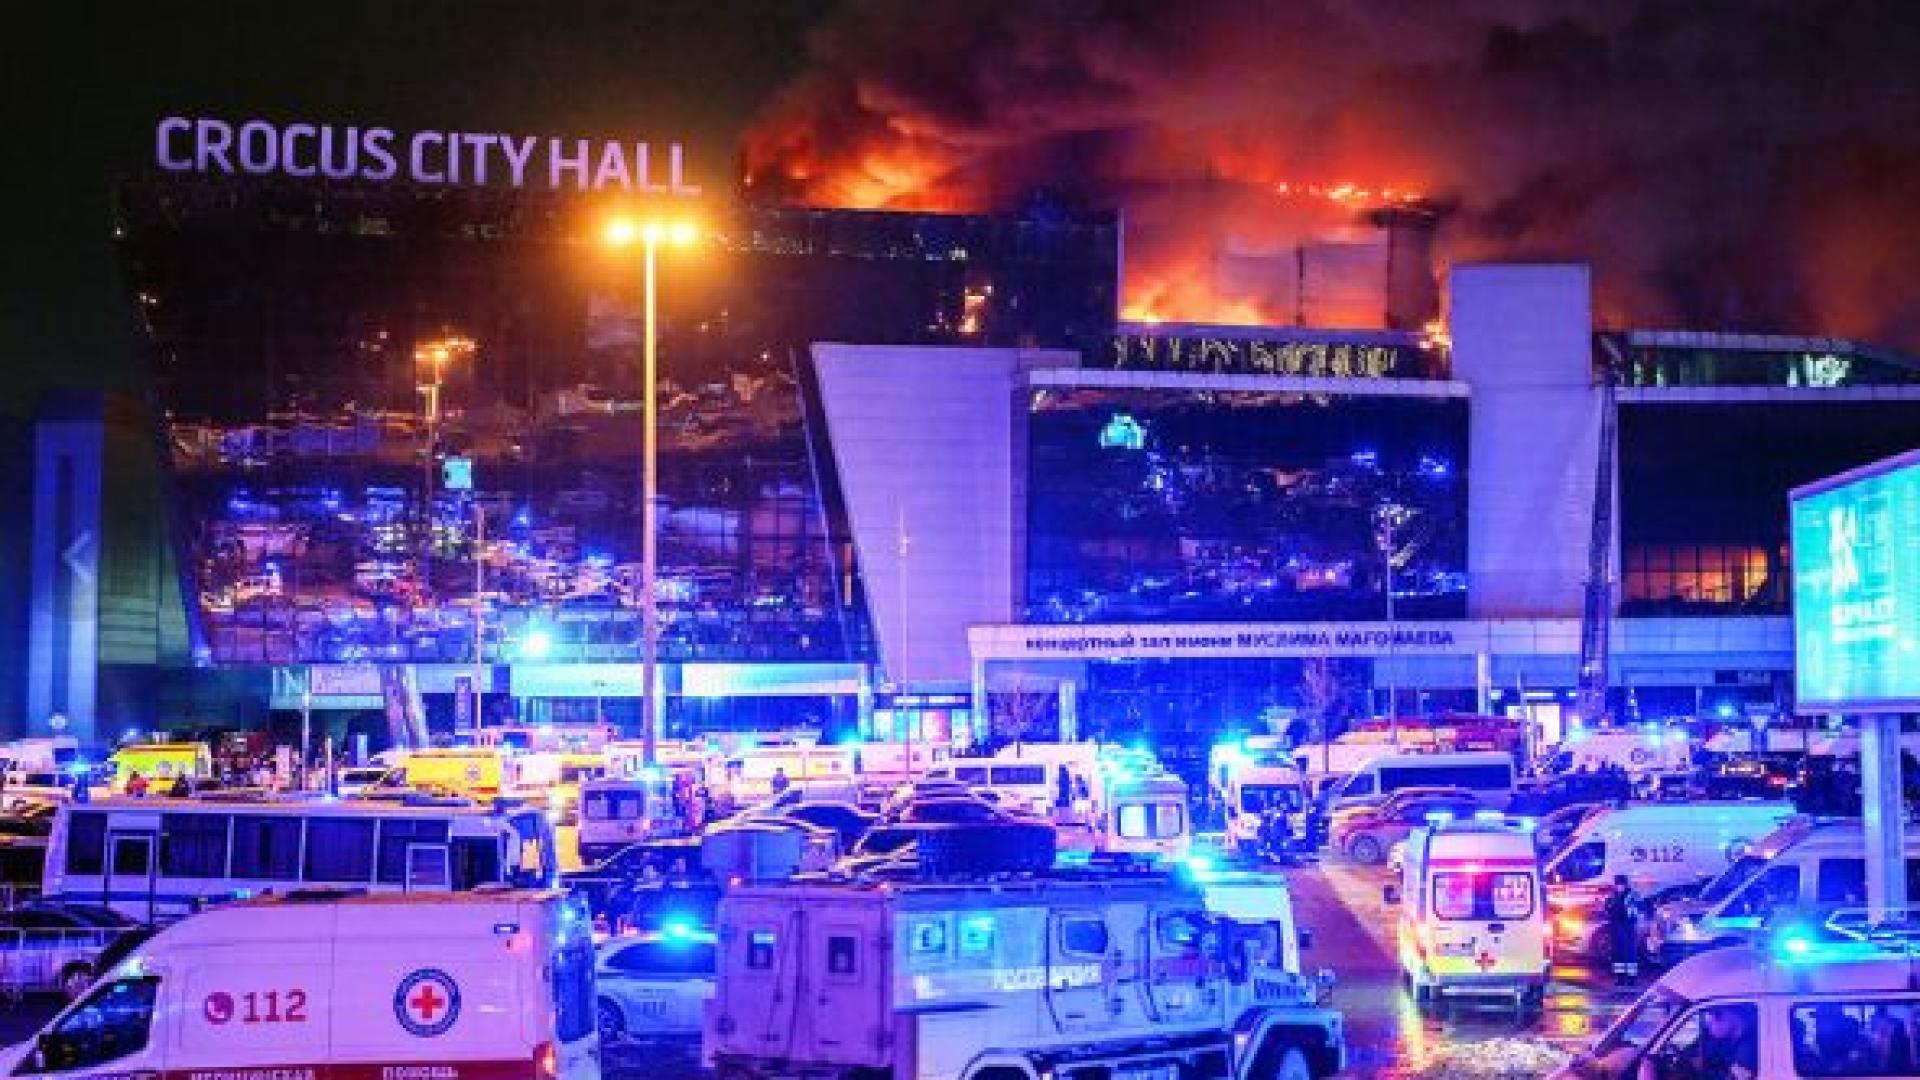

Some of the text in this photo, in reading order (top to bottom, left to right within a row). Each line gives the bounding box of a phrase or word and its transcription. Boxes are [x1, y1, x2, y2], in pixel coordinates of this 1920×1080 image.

[156, 115, 702, 197] CROCUS CITY HALL
[1650, 845, 1684, 863] 112
[242, 989, 307, 1023] 112
